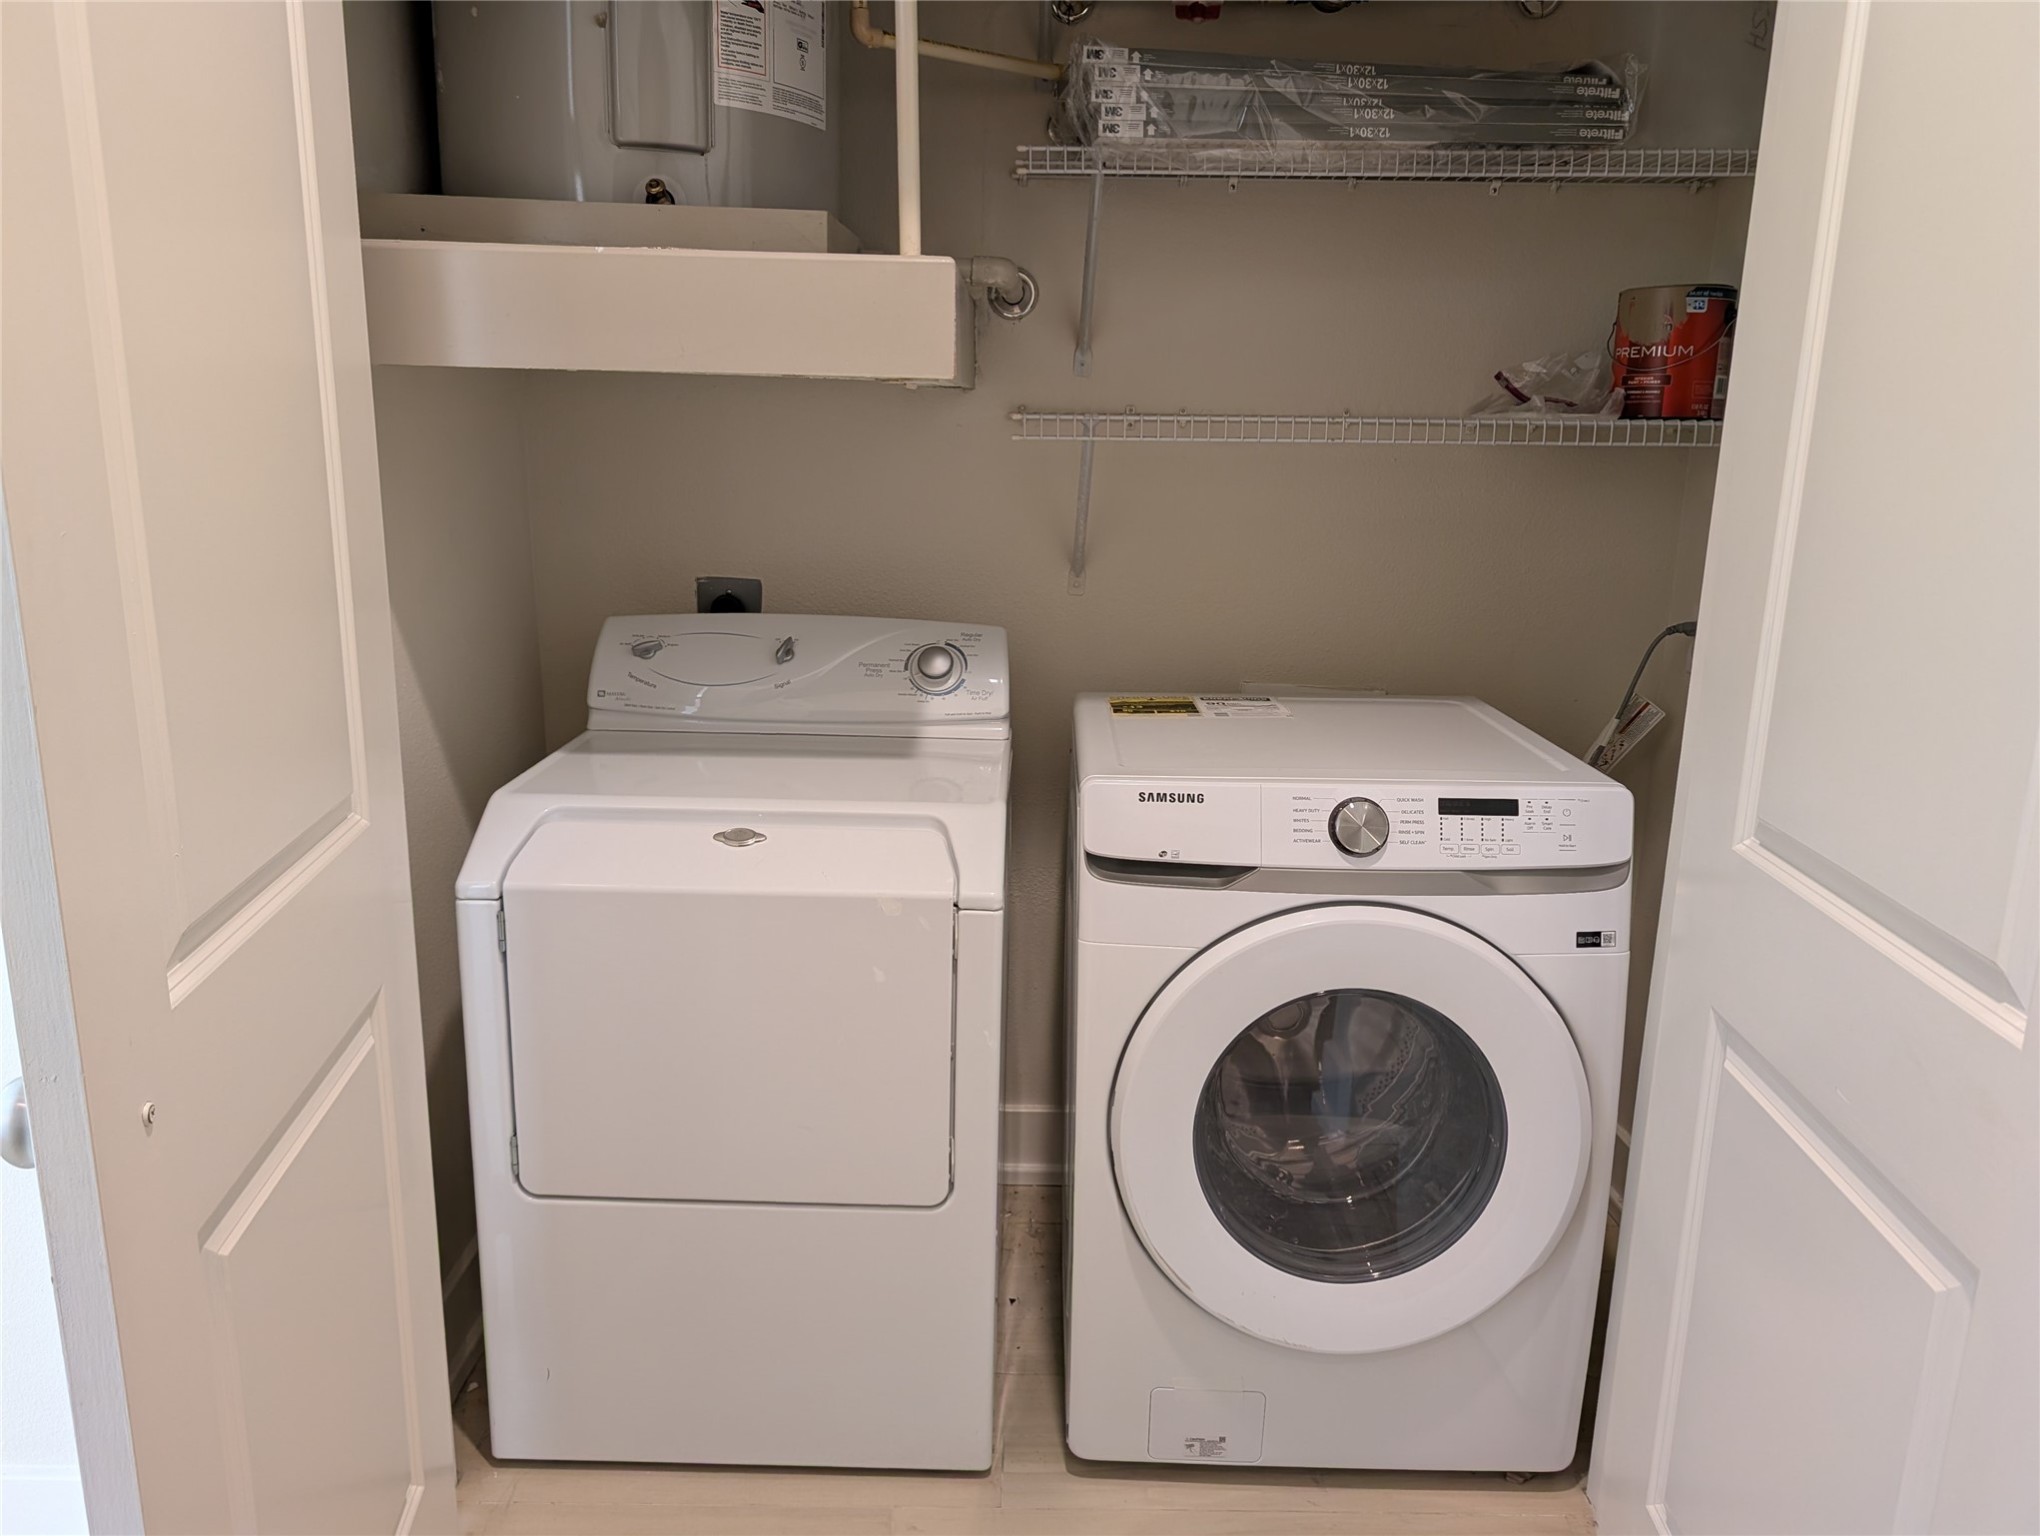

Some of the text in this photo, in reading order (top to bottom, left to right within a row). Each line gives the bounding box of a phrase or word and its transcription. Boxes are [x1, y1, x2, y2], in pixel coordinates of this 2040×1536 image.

[1086, 48, 1105, 60] 3M
[1335, 63, 1376, 76] 12x30x1
[1347, 77, 1389, 90] 12x30x1
[1576, 86, 1621, 99] Filtrete
[1104, 106, 1123, 117] 3M
[1354, 108, 1395, 119] 12x30x1
[1585, 110, 1630, 121] Filtrete
[1102, 123, 1121, 134] 3M
[1350, 127, 1391, 139] 12x30x1
[1579, 128, 1624, 140] Filtrete
[1615, 345, 1694, 358] PREMIUM
[960, 631, 983, 639] Regular
[627, 671, 657, 689] Temperature
[774, 679, 792, 690] Signal
[1138, 792, 1205, 804] SAMSUNG
